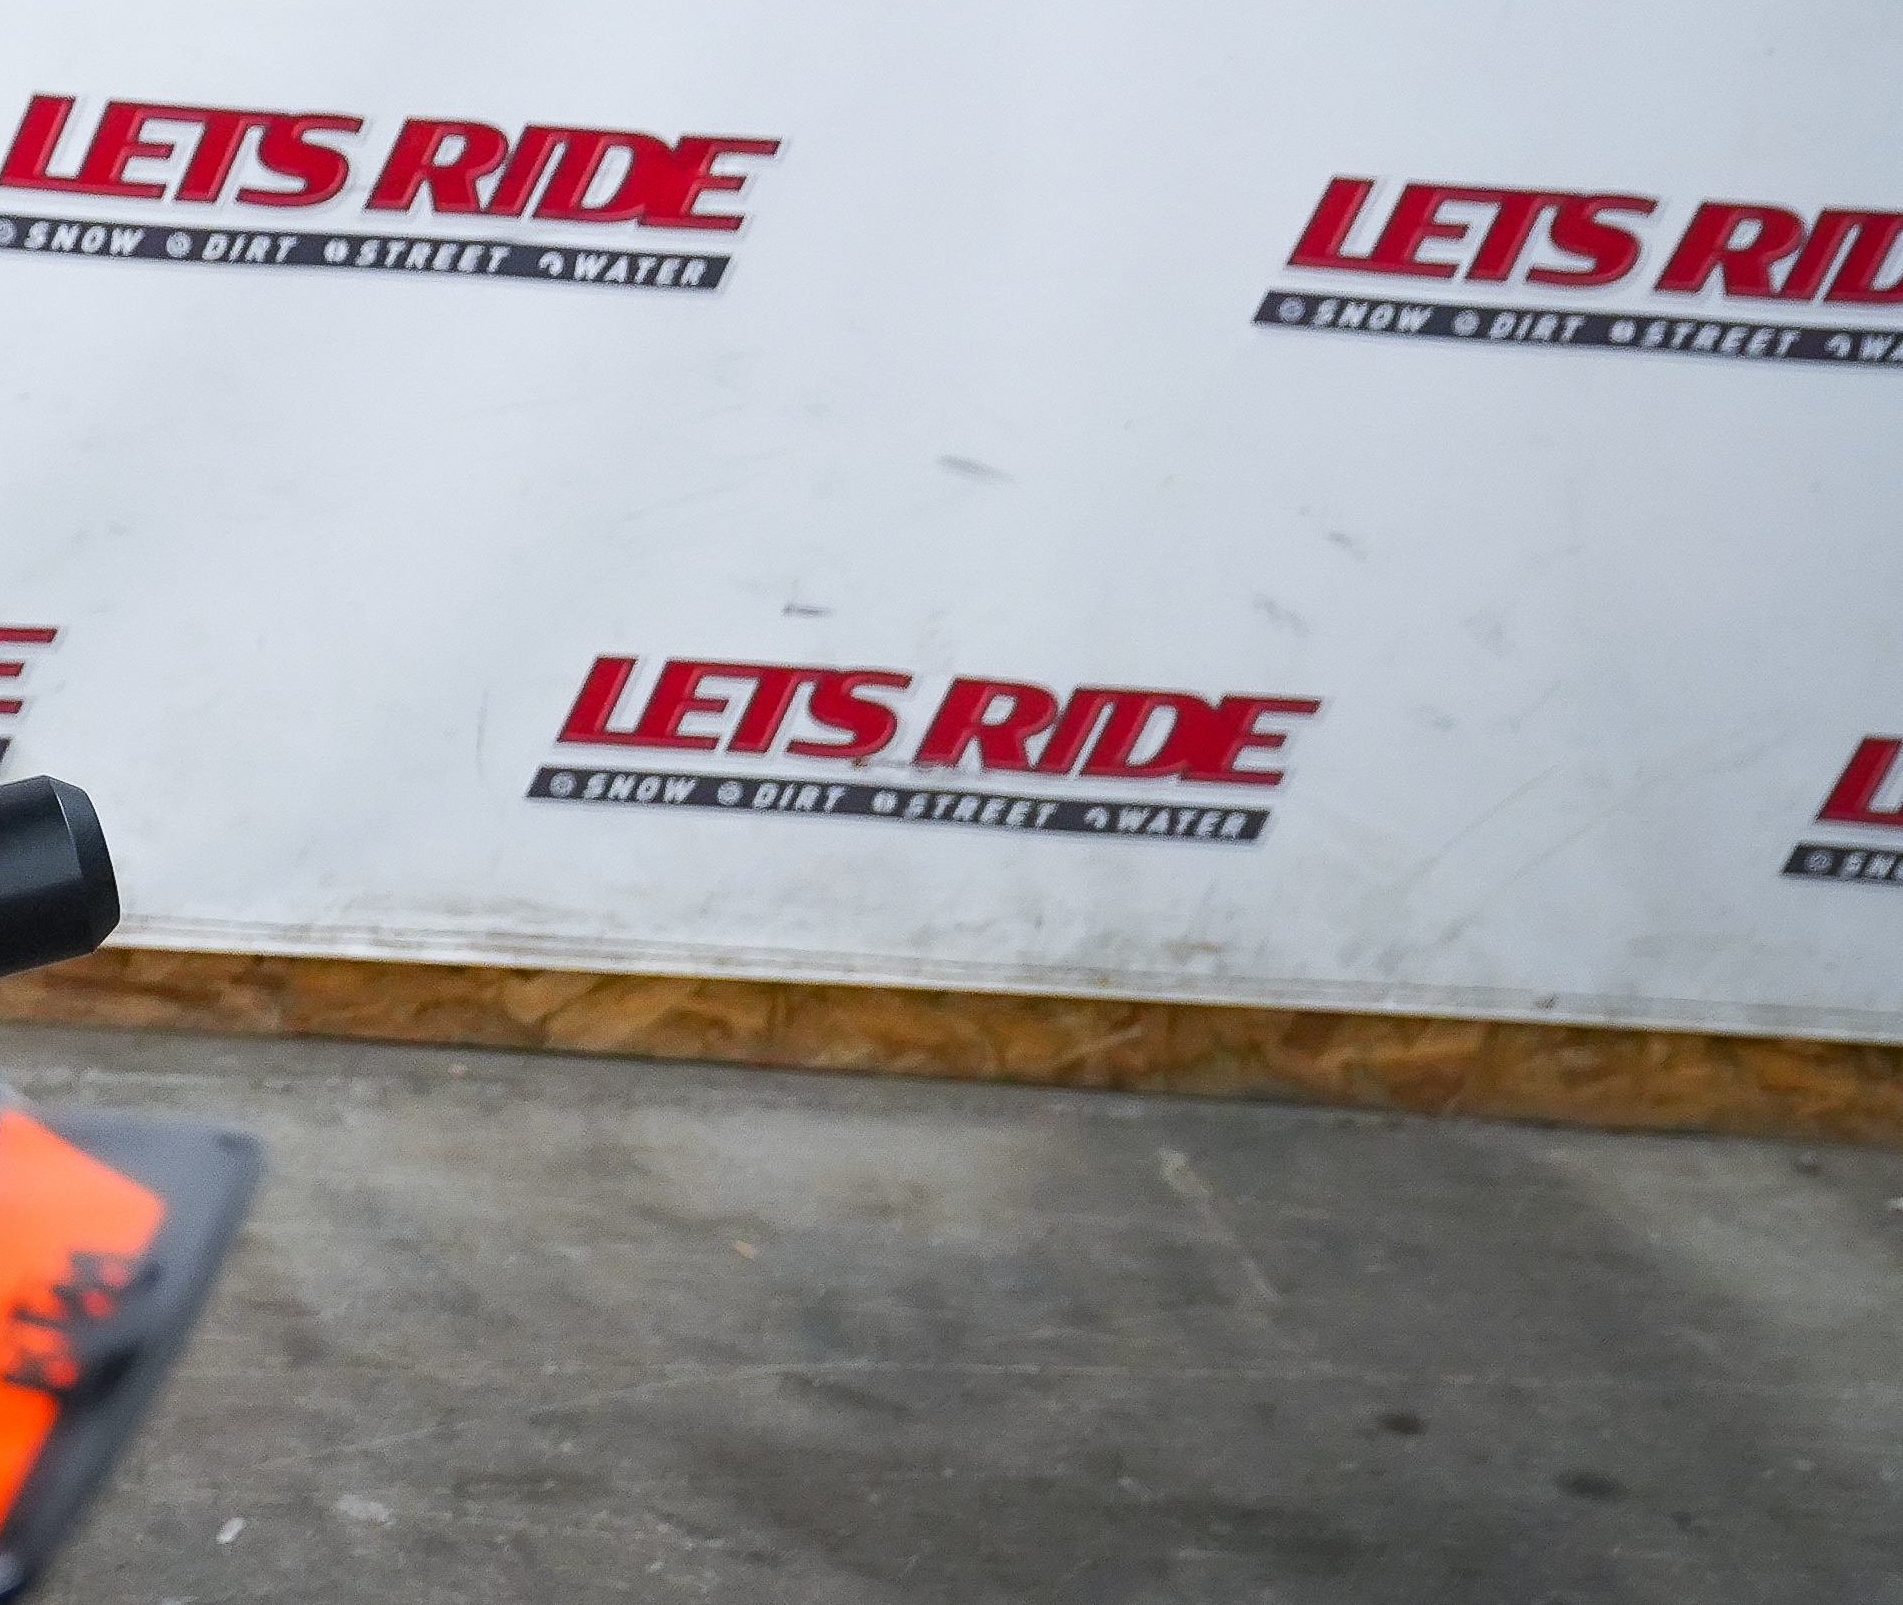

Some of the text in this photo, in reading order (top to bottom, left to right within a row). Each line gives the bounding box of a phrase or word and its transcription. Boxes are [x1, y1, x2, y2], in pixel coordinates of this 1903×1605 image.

[367, 117, 778, 232] RIDE
[23, 220, 707, 285] SNOW DIRT STREET WATER
[1289, 175, 1655, 288] LETS
[1311, 298, 1798, 356] SNOW DIRT STREET
[559, 654, 1319, 787] LETS RIDE
[581, 772, 1247, 838] SNOW DIRT STREET WATER
